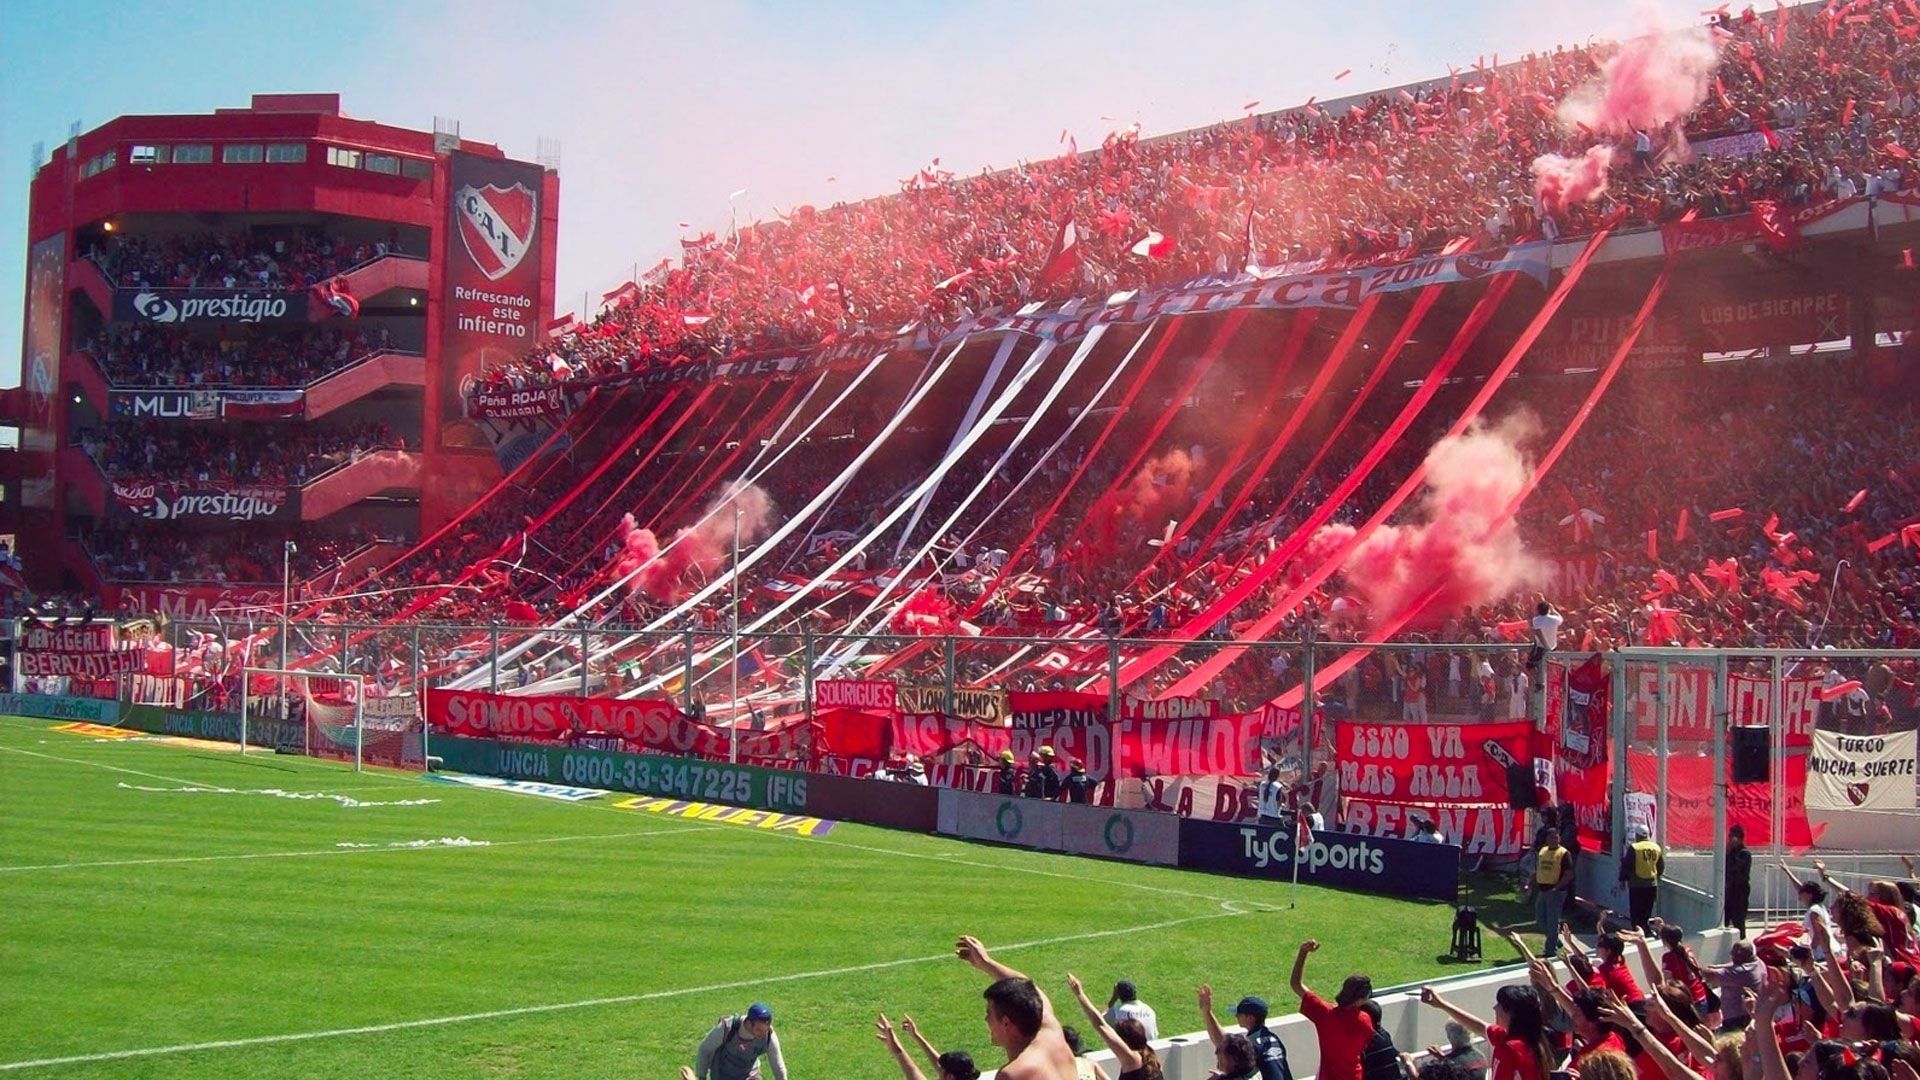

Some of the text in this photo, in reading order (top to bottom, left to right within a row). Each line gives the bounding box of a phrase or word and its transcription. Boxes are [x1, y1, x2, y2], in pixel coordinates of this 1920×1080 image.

[1368, 257, 1442, 292] 2010
[180, 294, 287, 323] prestigio
[455, 286, 531, 309] Refrescando
[1762, 294, 1838, 318] SIEMPRE
[458, 314, 526, 338] infierno
[492, 306, 521, 321] este
[134, 396, 226, 416] MULI
[511, 390, 547, 404] ROJA
[485, 405, 545, 418] OLAVARRIA
[23, 648, 146, 676] BERAZATEGUI
[818, 682, 894, 708] SOURIGUES
[919, 687, 1000, 722] LONHAMPS
[444, 694, 558, 734] SOMOS
[1141, 712, 1263, 777] WILDE
[1351, 726, 1465, 760] ESTO VA
[1836, 736, 1885, 753] TURCO
[562, 753, 751, 802] 0800-33-347225
[1341, 759, 1396, 797] MAS
[1409, 764, 1483, 799] ALLA
[1811, 756, 1915, 778] MUCHA SUERTE
[612, 796, 823, 837] LA NUEVA
[1343, 801, 1521, 855] BERNAL
[1239, 827, 1289, 868] TyC
